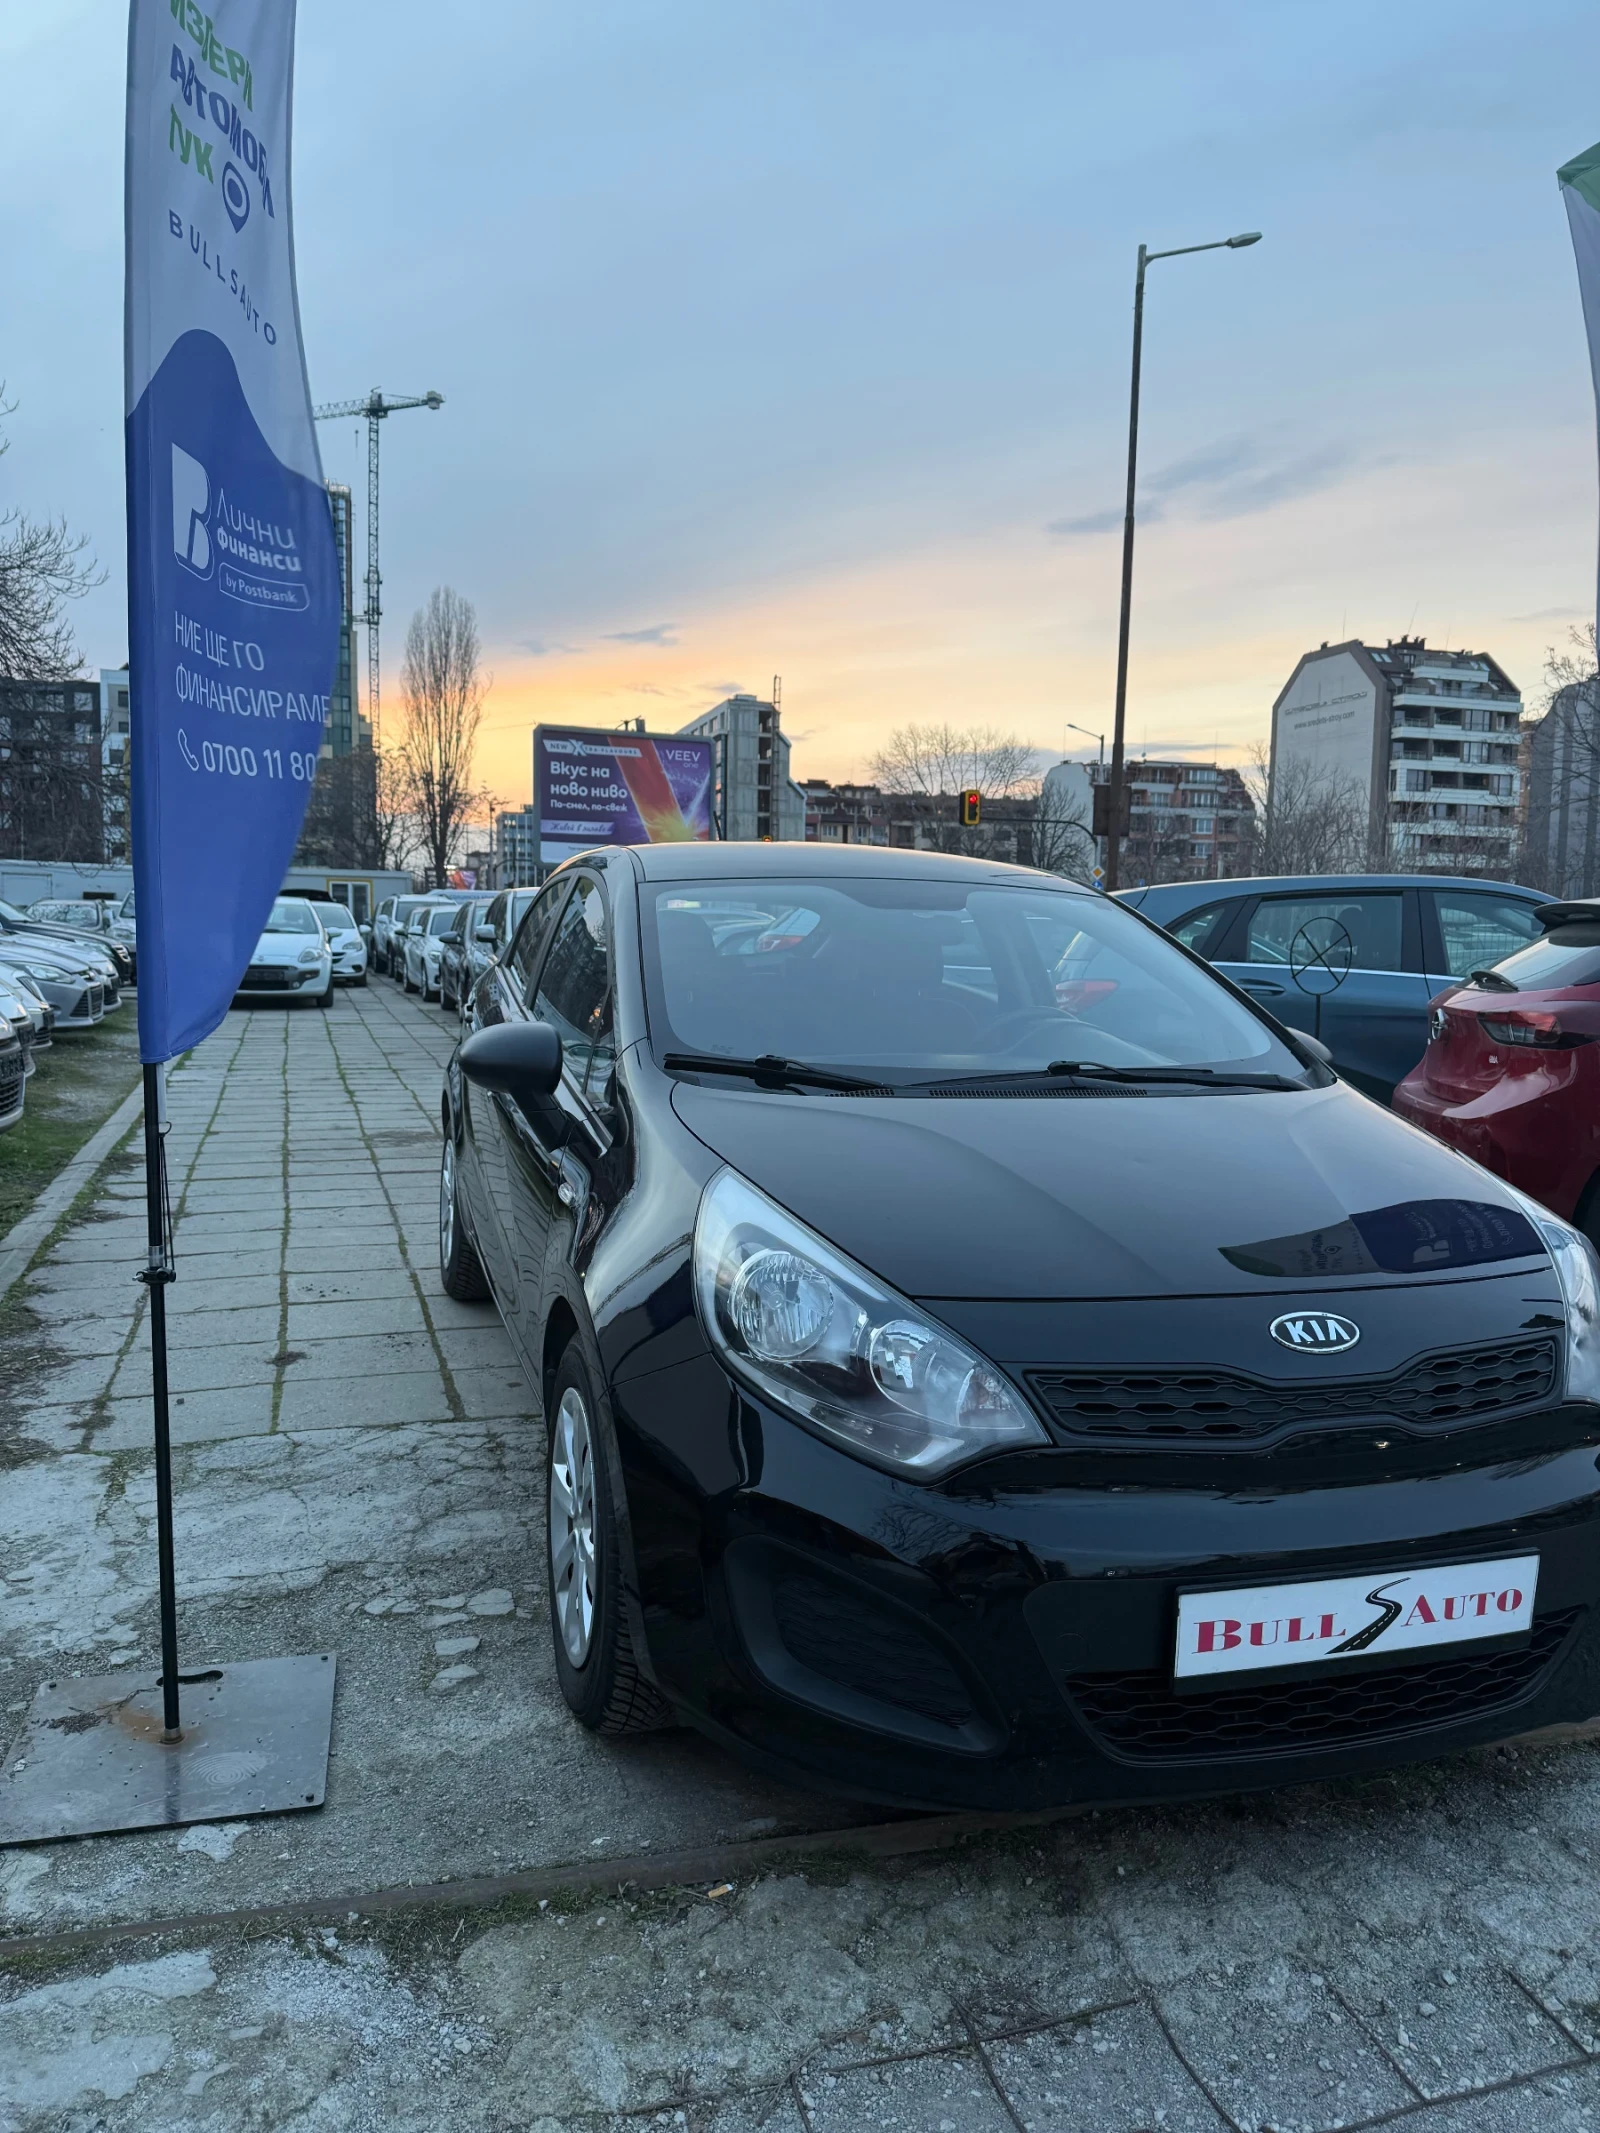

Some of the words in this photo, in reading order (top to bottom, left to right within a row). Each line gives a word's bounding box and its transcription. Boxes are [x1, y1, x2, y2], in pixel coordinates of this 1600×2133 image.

[169, 209, 277, 346] BULLSAUTO
[216, 488, 297, 550] Лични
[226, 573, 237, 592] by
[238, 579, 298, 603] Postbank
[174, 610, 202, 655] НИЕ
[205, 627, 230, 669] ЩЕ
[233, 641, 266, 671] ГО
[175, 662, 331, 723] ФИНАНСИРАМЕ
[202, 740, 258, 777] 0700
[263, 749, 283, 780] 11
[550, 742, 568, 751] NEW
[665, 749, 701, 762] VEEV
[550, 761, 588, 779] Вкус
[590, 767, 610, 778] на
[550, 781, 588, 797] ново
[590, 784, 628, 799] ниво
[550, 799, 590, 812] По-смел,
[1283, 1319, 1352, 1343] KIA
